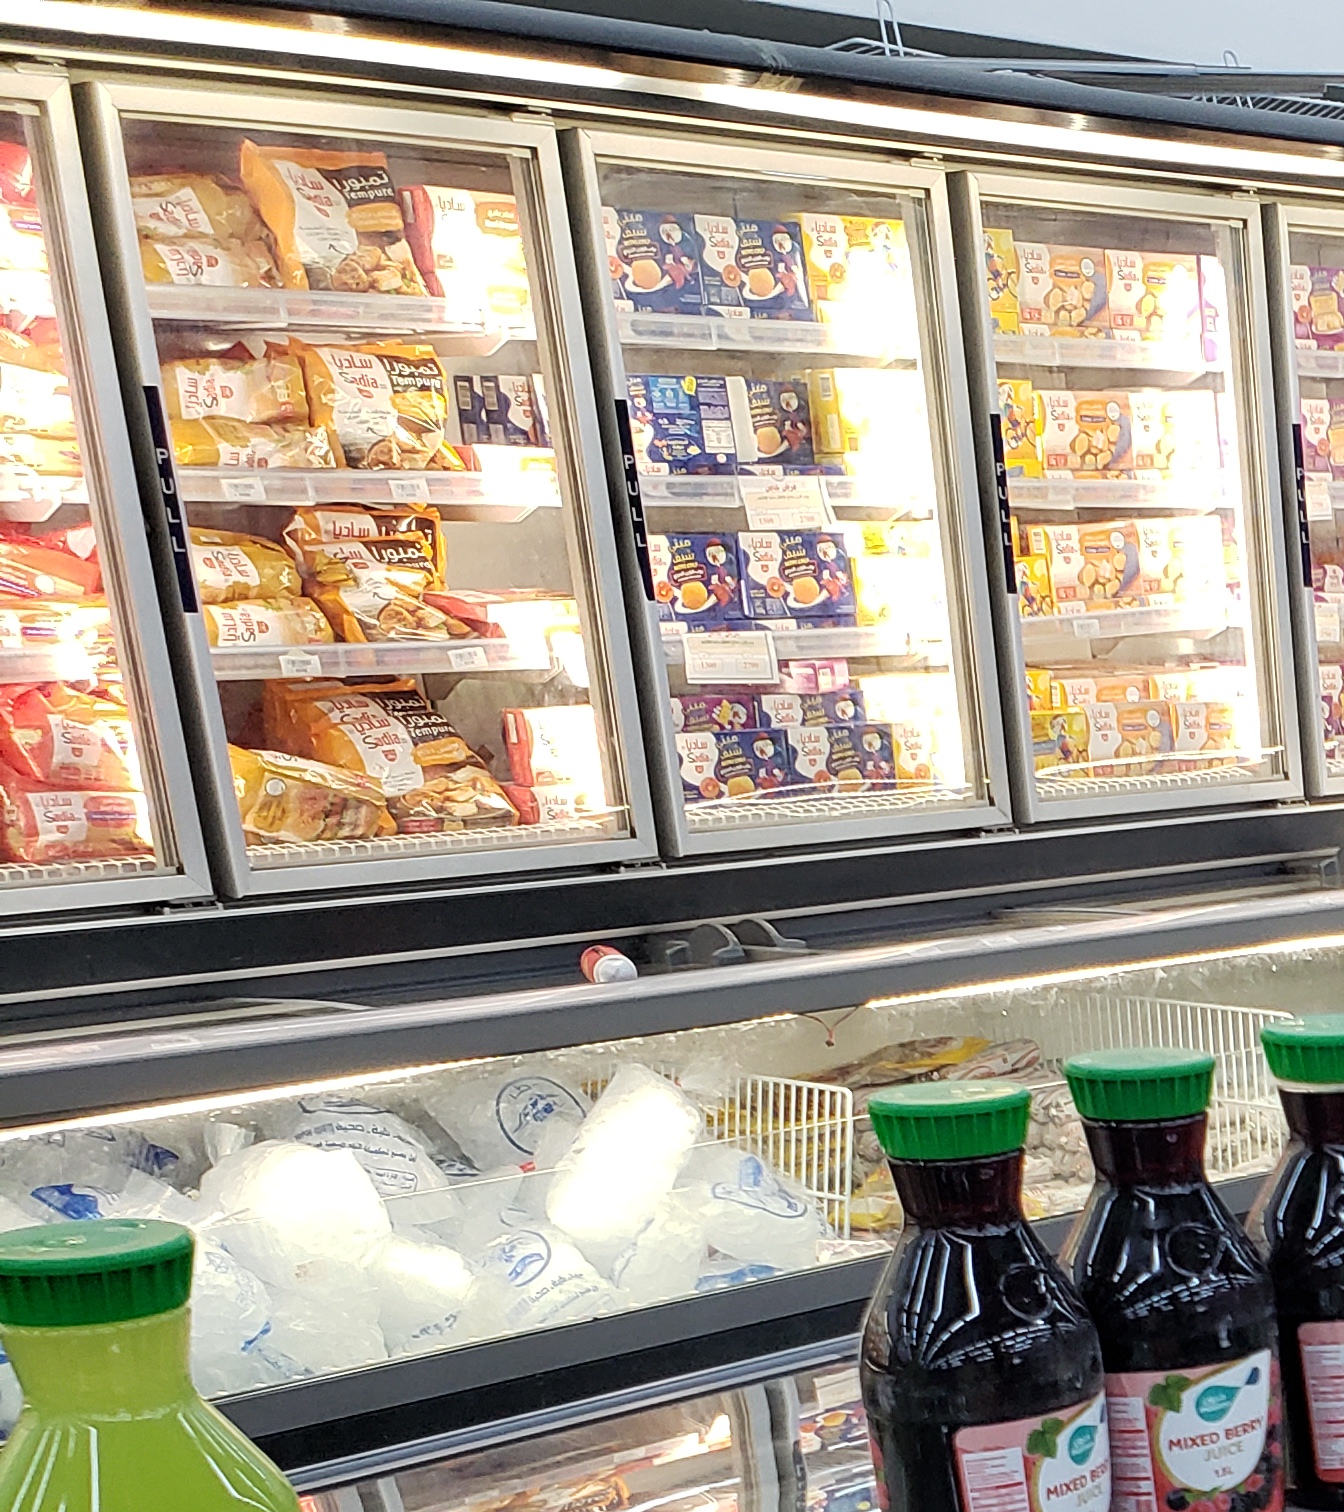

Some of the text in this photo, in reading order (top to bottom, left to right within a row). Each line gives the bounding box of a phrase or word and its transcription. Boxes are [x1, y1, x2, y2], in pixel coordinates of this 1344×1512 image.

[331, 172, 388, 191] تمبورا
[332, 352, 374, 371] ساديا
[382, 358, 438, 376] تمبورا
[156, 448, 186, 553] PULL
[623, 453, 647, 547] PULL
[996, 462, 1013, 546] PULL
[1297, 467, 1309, 543] PULL
[363, 733, 400, 749] Sadia
[1168, 1416, 1265, 1452] MIXED BERRY
[1203, 1441, 1245, 1462] JUICE
[1046, 1474, 1088, 1501] MIXED
[1076, 1486, 1105, 1507] JUICE
